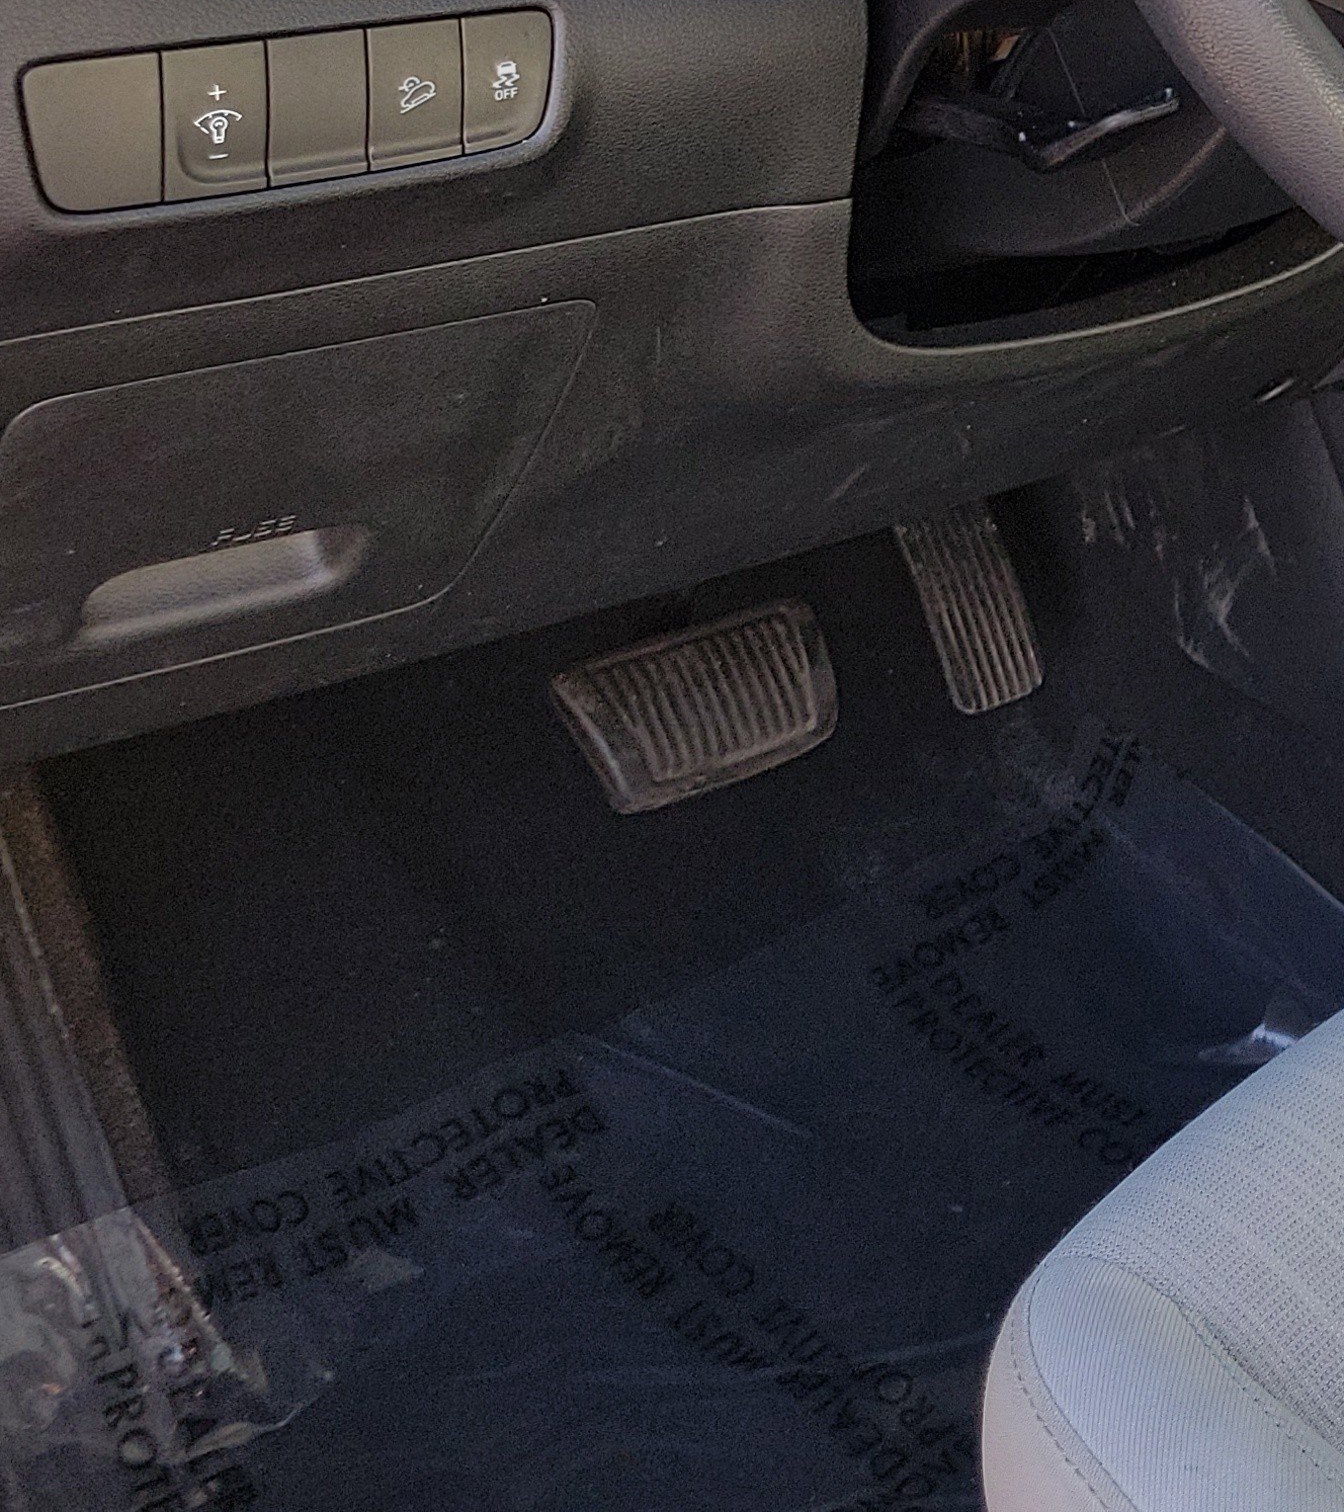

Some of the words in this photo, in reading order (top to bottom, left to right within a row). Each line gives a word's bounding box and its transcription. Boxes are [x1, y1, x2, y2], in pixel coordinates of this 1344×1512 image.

[494, 87, 518, 101] OFF
[325, 1069, 577, 1205] PROTECTIVE
[445, 1105, 606, 1201] DEALER
[300, 1196, 419, 1277] MUST
